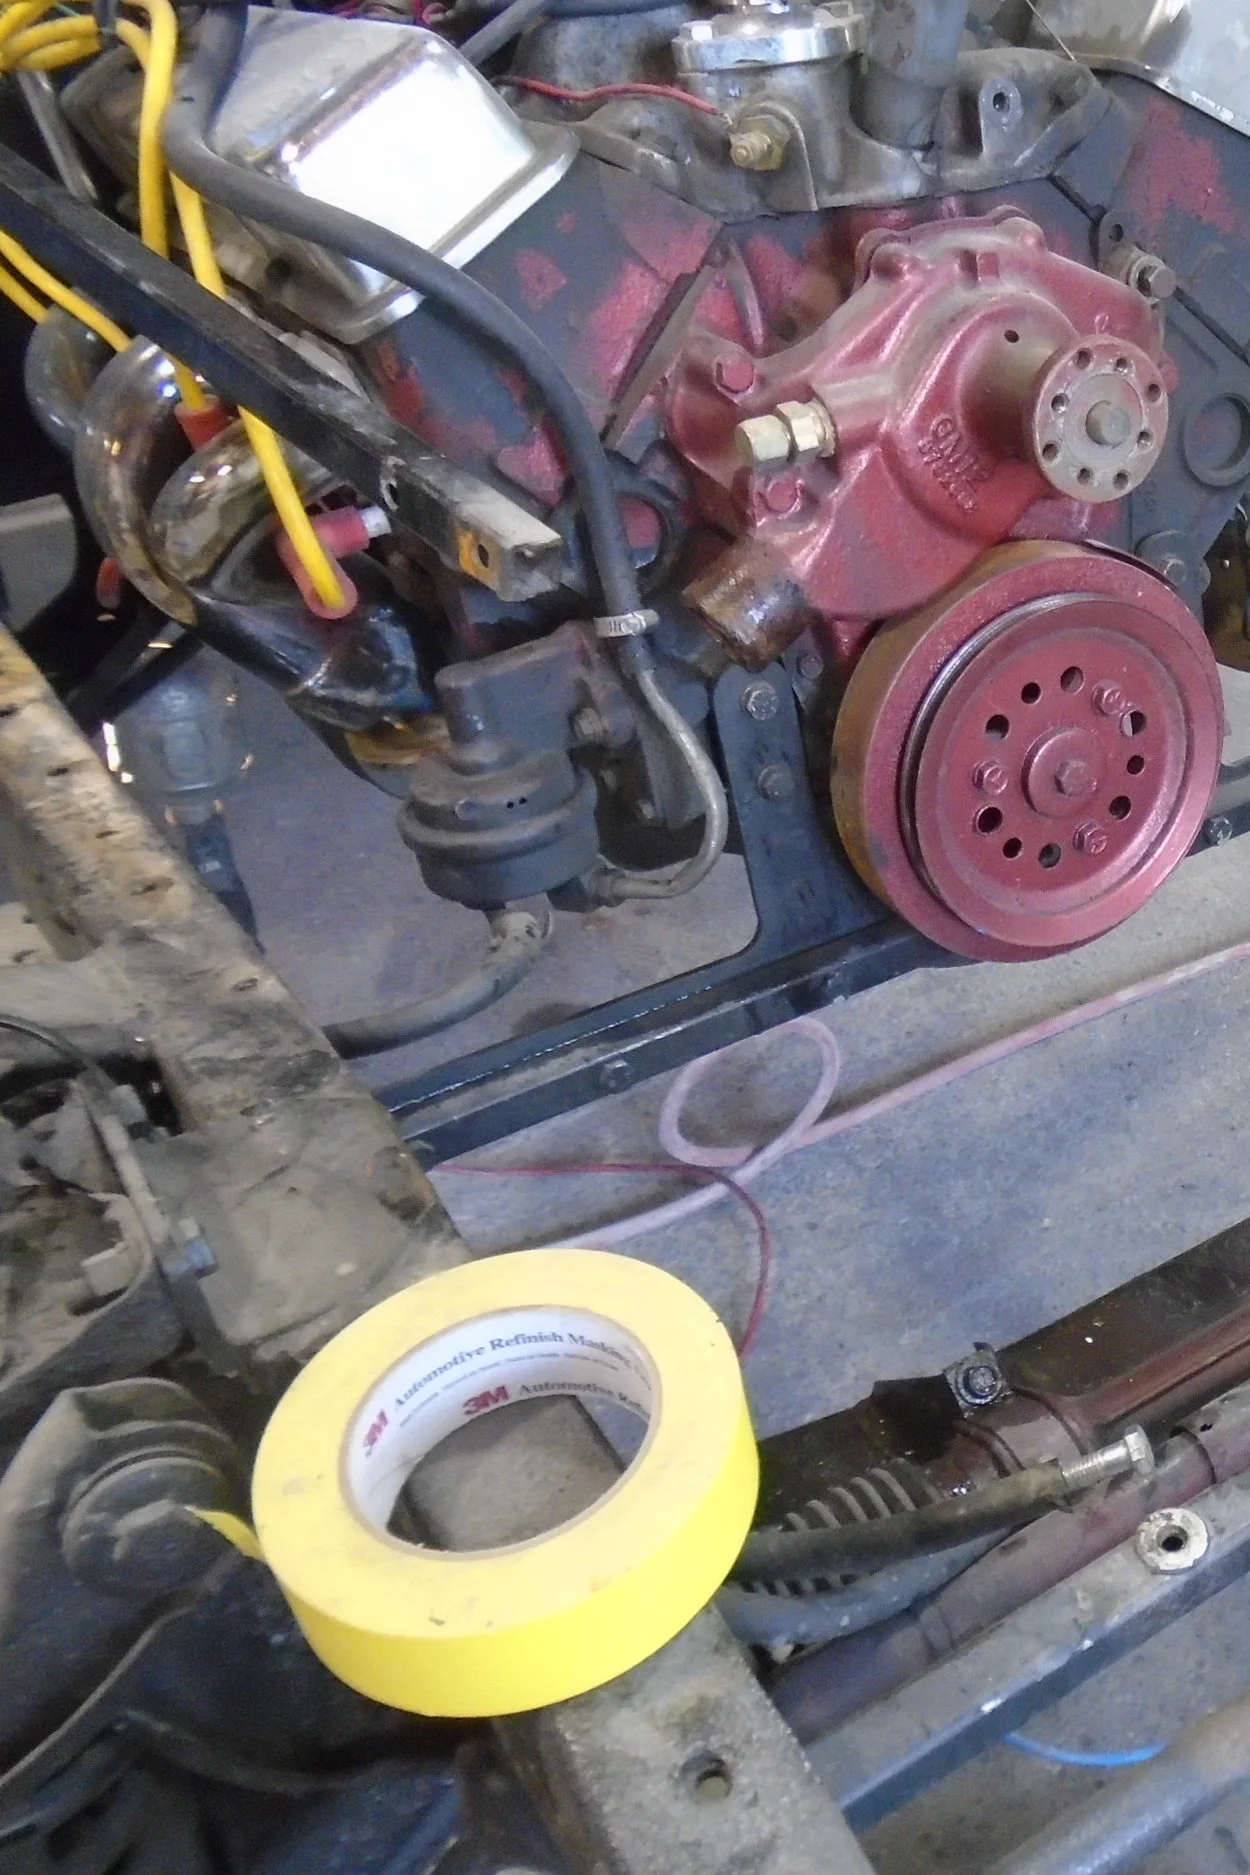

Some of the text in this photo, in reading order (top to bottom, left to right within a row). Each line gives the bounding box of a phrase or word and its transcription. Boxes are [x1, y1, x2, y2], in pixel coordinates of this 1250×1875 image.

[362, 1409, 388, 1457] 3M
[394, 1346, 486, 1412] Automotive
[489, 1331, 564, 1351] Refinish
[568, 1332, 633, 1370] Masking
[462, 1385, 510, 1416] 3M
[519, 1381, 614, 1397] Automotive
